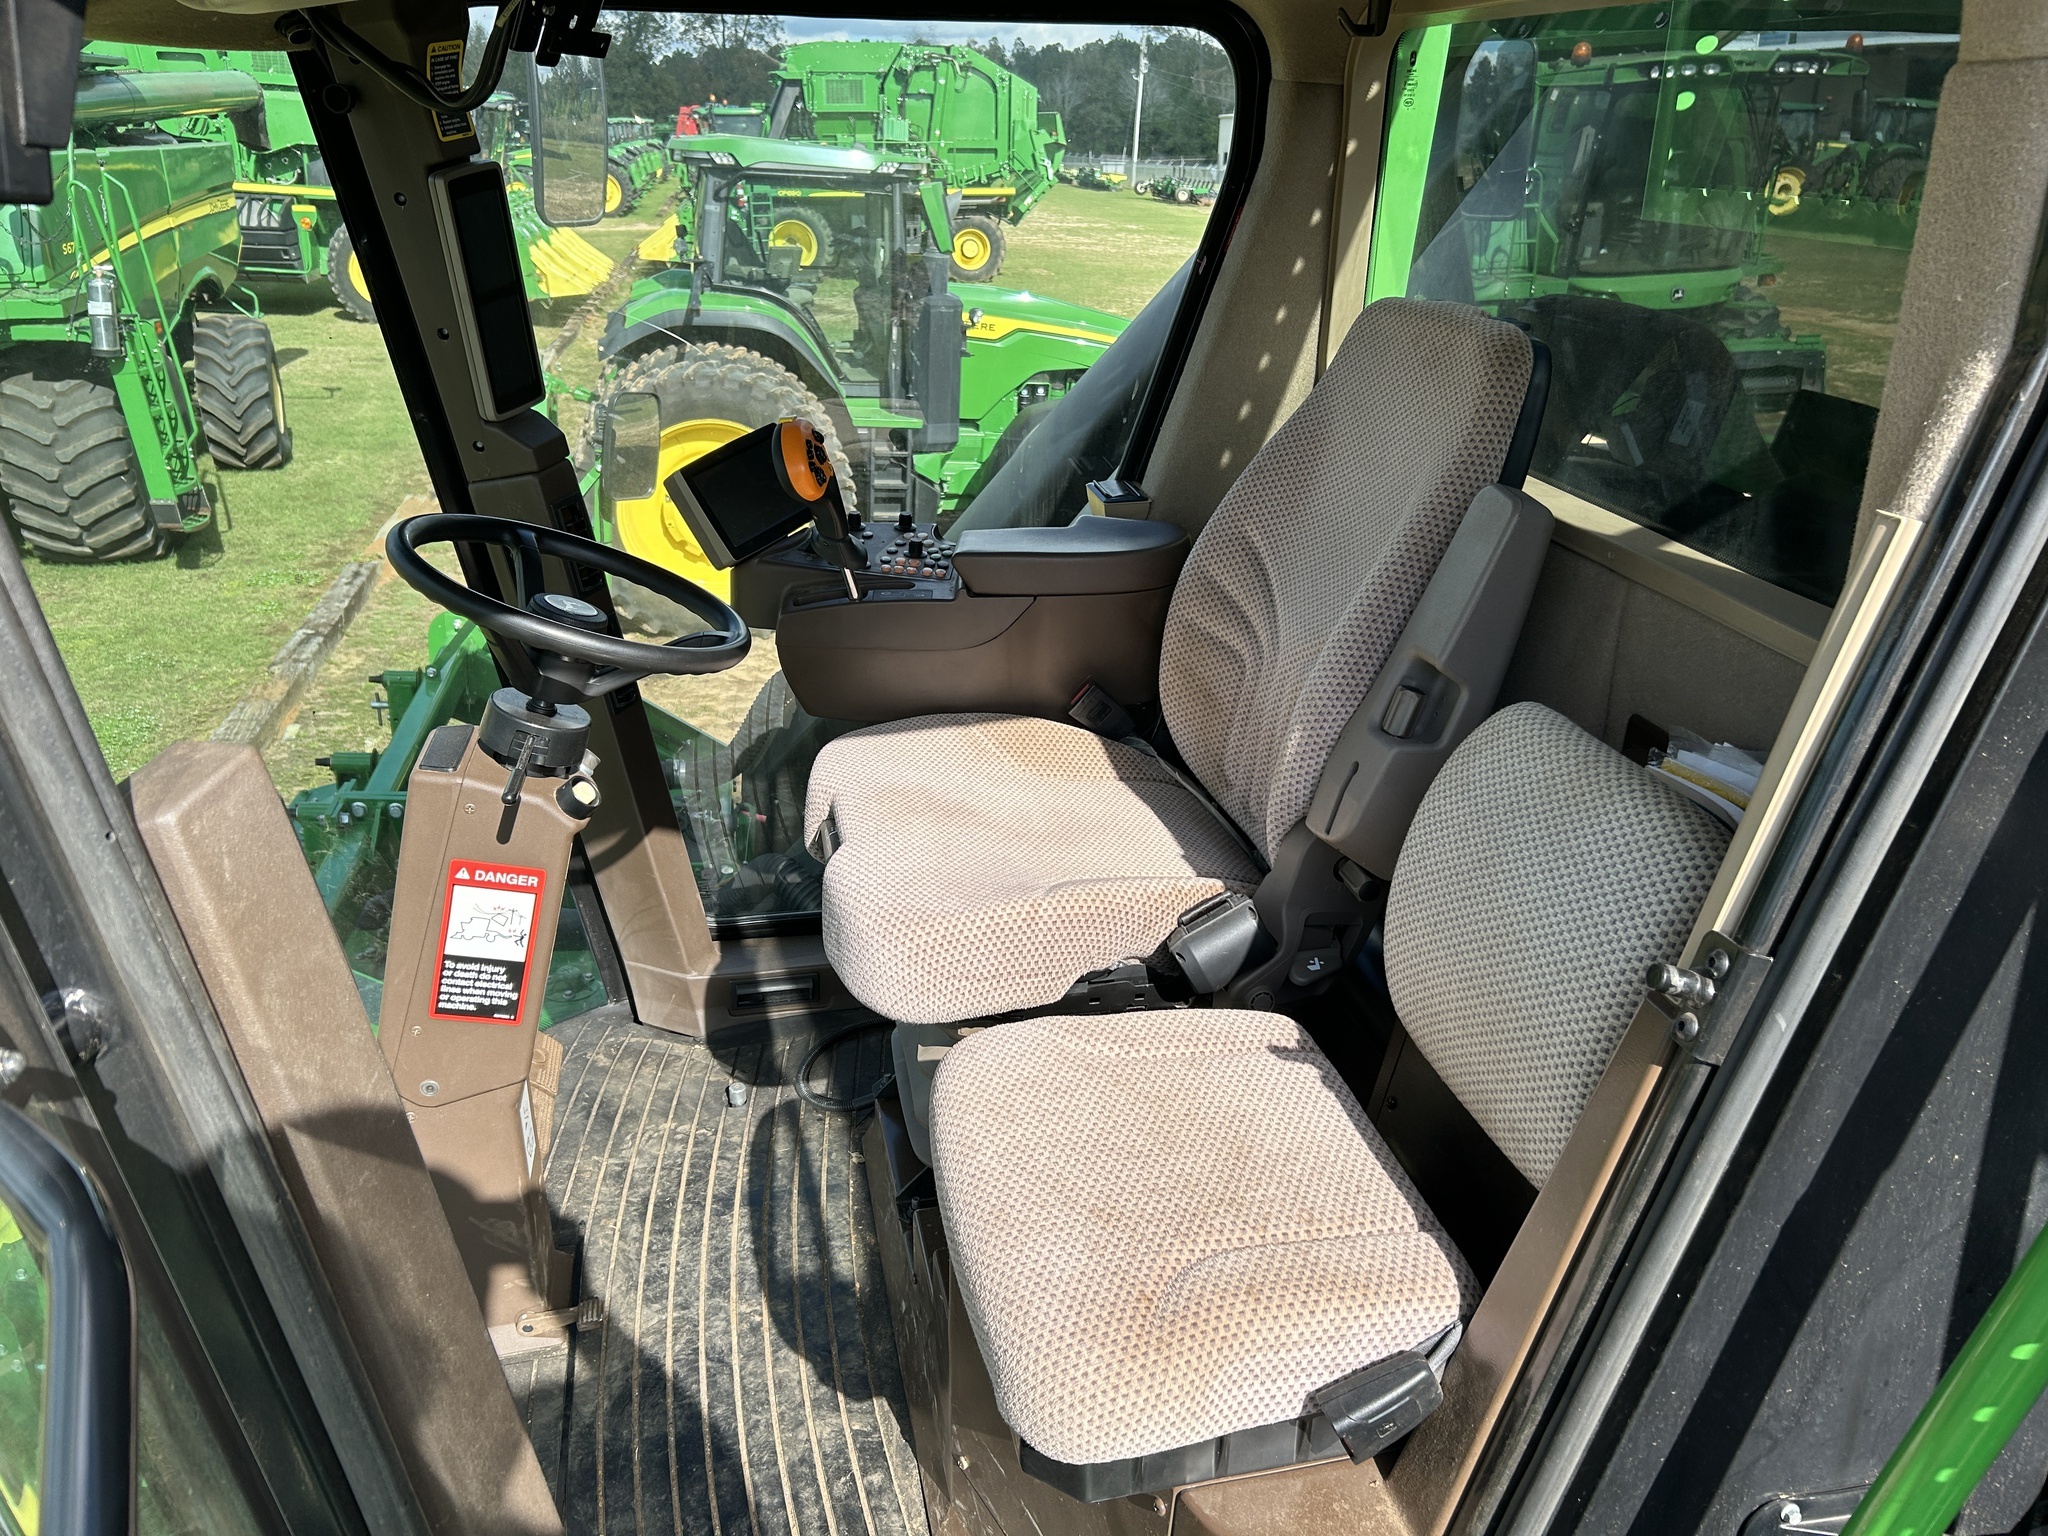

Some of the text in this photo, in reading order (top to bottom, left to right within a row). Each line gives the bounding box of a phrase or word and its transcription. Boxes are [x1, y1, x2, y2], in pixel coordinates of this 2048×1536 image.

[437, 44, 461, 52] CAUTION
[62, 241, 75, 255] S67
[474, 869, 539, 888] DANGER
[444, 960, 507, 975] To avoid injury
[442, 969, 454, 977] or
[453, 970, 479, 979] death
[492, 974, 508, 982] not
[441, 978, 513, 991] contact electrical
[440, 984, 519, 1001] lines when moving
[438, 1001, 477, 1011] machine.
[439, 993, 508, 1006] or operating this
